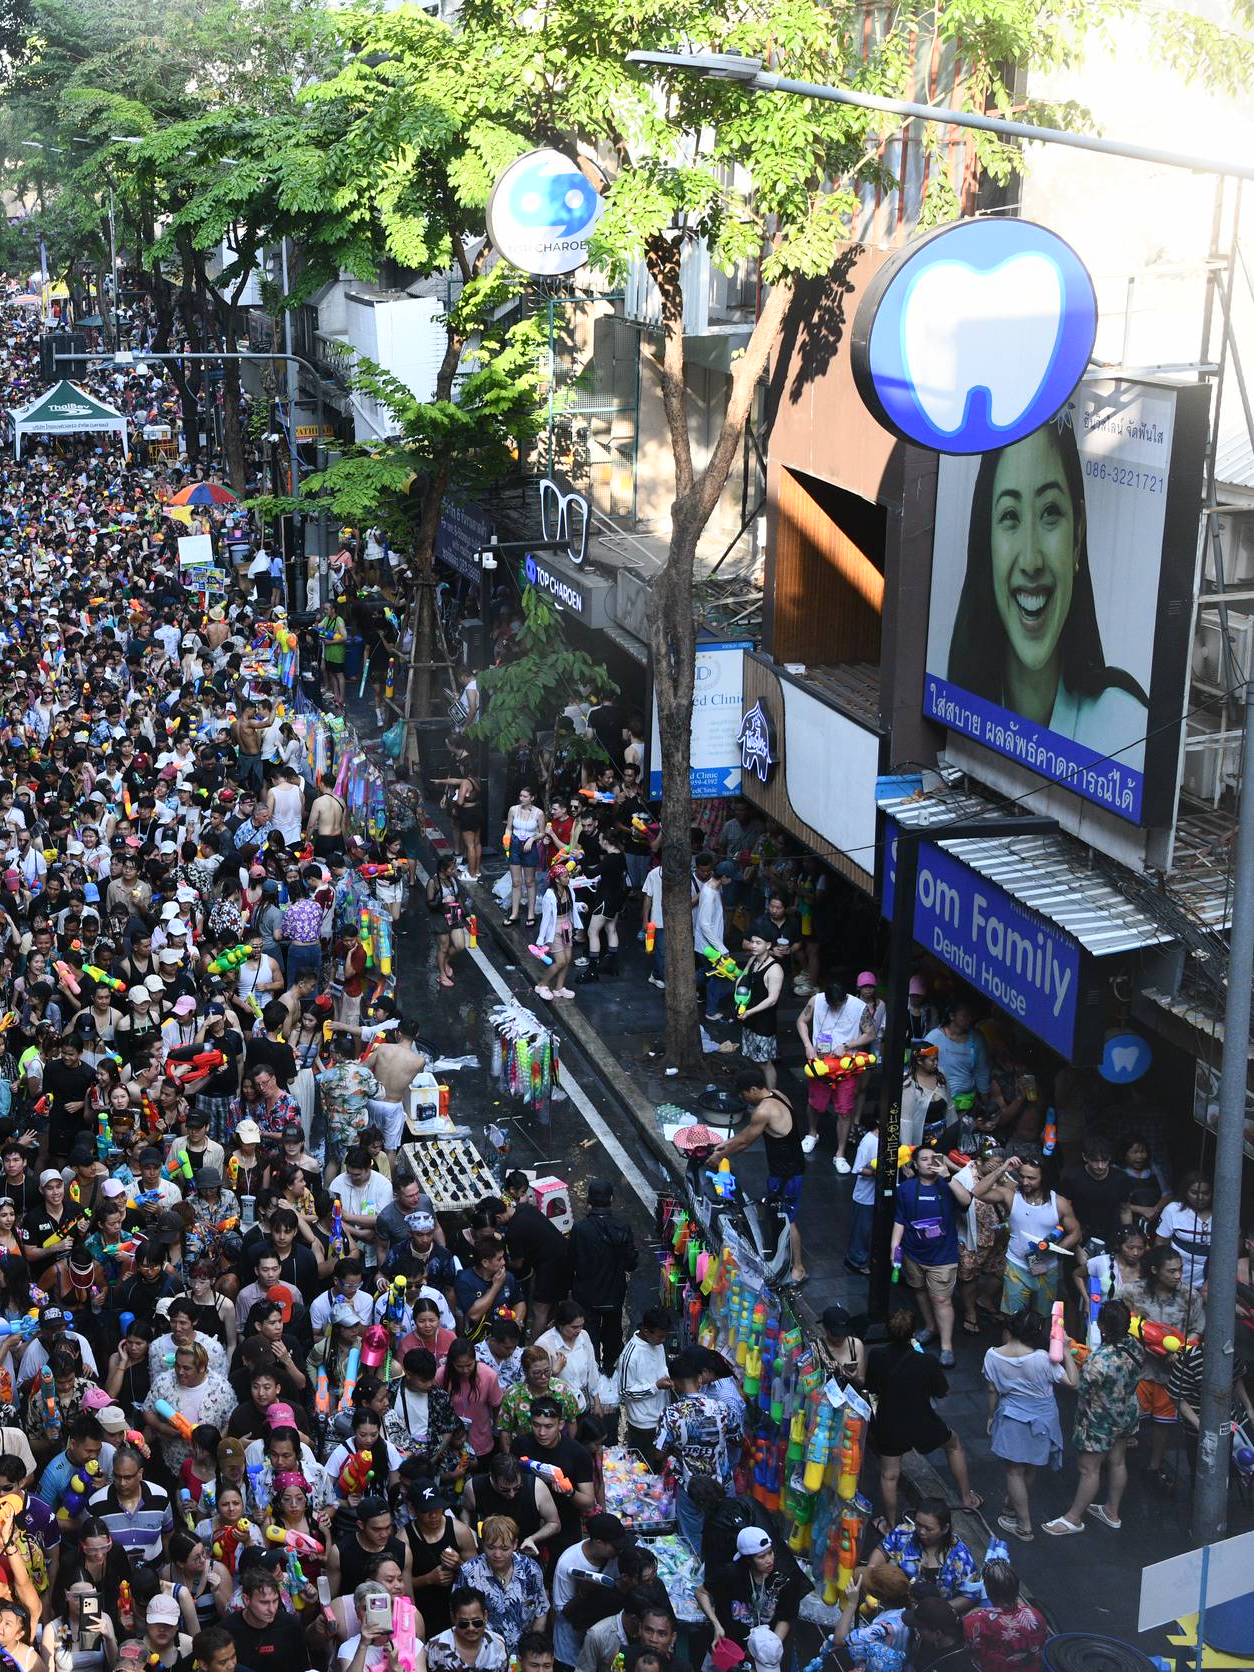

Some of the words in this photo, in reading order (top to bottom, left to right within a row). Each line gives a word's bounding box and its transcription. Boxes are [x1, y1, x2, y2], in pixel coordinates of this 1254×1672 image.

[1086, 461, 1164, 494] 086-3221721
[536, 566, 550, 588] TOP
[549, 577, 583, 613] CHAROEN
[930, 682, 981, 736] ใส่สบาย
[985, 720, 1136, 813] ผลลัพธ์คาดการณ์ได้
[933, 926, 977, 979] Dental
[981, 961, 1027, 1016] House
[972, 892, 1072, 1017] Family
